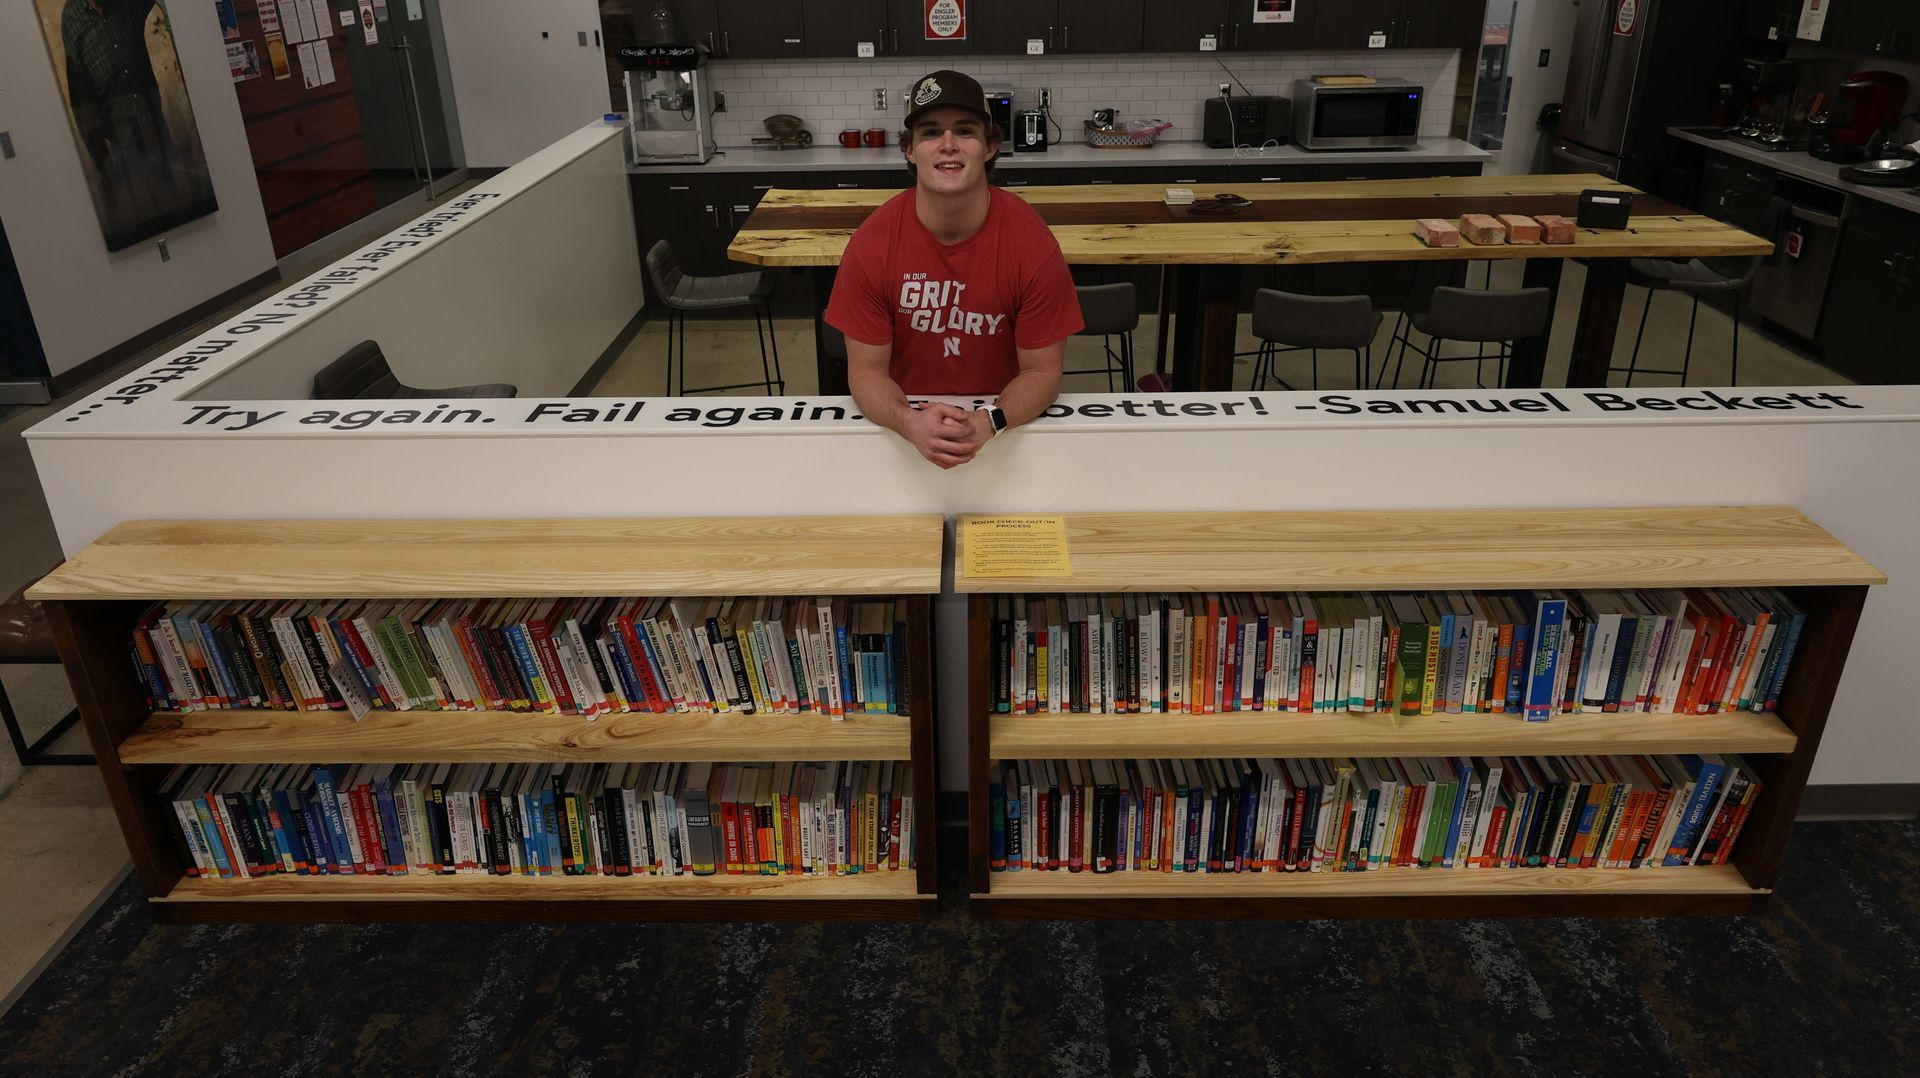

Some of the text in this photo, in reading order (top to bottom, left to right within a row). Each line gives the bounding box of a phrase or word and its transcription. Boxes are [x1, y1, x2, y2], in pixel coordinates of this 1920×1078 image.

[66, 193, 500, 422] Ever tried? Ever failed? No matter...
[900, 280, 966, 309] GRIT
[944, 337, 961, 358] N
[182, 406, 286, 430] Try
[299, 404, 495, 430] again.
[524, 401, 646, 422] Fail
[664, 402, 864, 428] again.
[1295, 392, 1571, 414] -Samuel
[1583, 390, 1864, 412] Beckett
[301, 638, 319, 658] Rules
[314, 667, 333, 690] Thumb
[628, 639, 656, 701] GOOD TO GREAT
[788, 641, 799, 656] 301
[1426, 631, 1439, 682] SIDE HUSTLE
[1451, 642, 1466, 695] DONE DEALS
[322, 782, 334, 806] MARKET
[331, 809, 342, 834] ANALYSIS
[613, 797, 622, 826] ANDREW
[304, 812, 322, 856] CLOUD SURFING
[569, 817, 581, 856] THINKERTOYS
